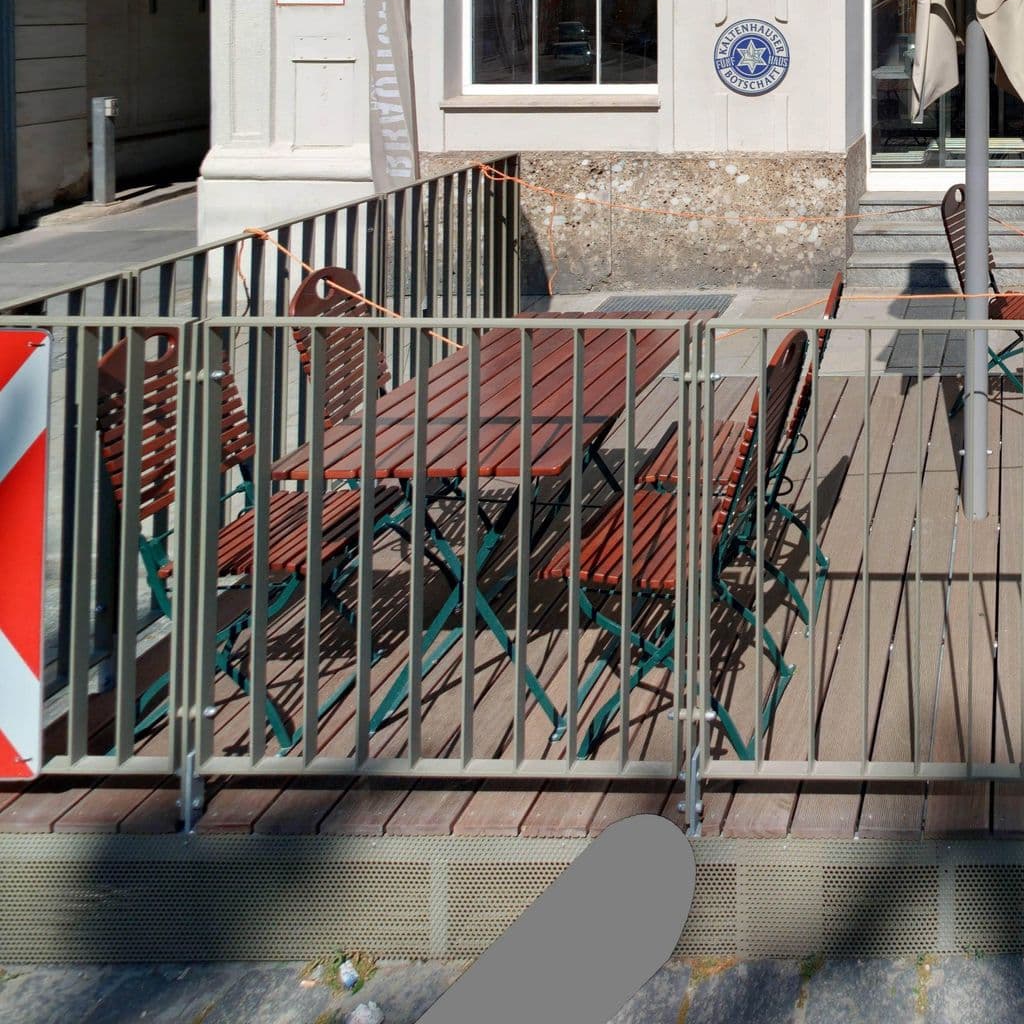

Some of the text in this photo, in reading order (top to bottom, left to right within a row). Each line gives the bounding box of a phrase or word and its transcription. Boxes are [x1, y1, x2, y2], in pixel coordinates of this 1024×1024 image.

[718, 23, 785, 55] KALTENHAUSER
[768, 55, 789, 68] HAUS
[724, 67, 781, 90] BOTSCHAFT
